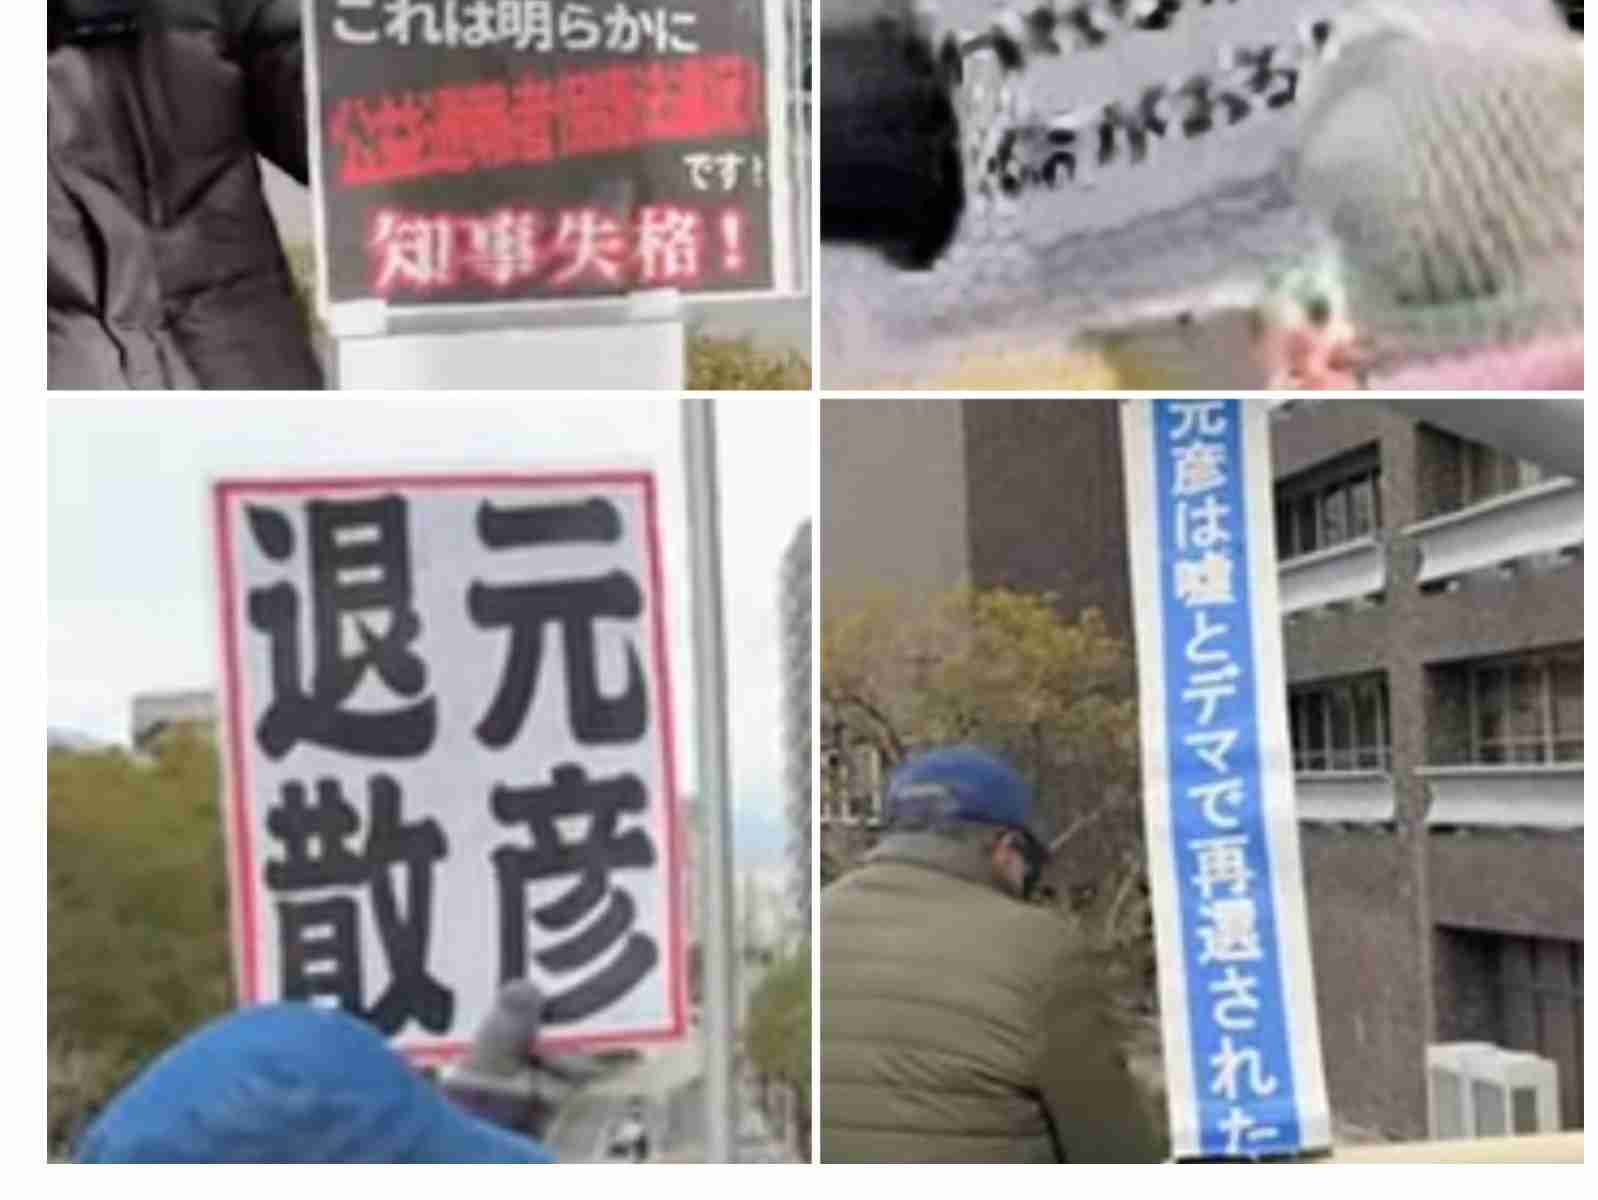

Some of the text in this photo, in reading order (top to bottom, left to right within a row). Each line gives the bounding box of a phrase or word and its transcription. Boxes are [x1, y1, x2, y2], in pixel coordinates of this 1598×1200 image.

[371, 204, 749, 292] 知事失格！
[243, 493, 456, 1037] 退散
[466, 496, 660, 1026] 元彦
